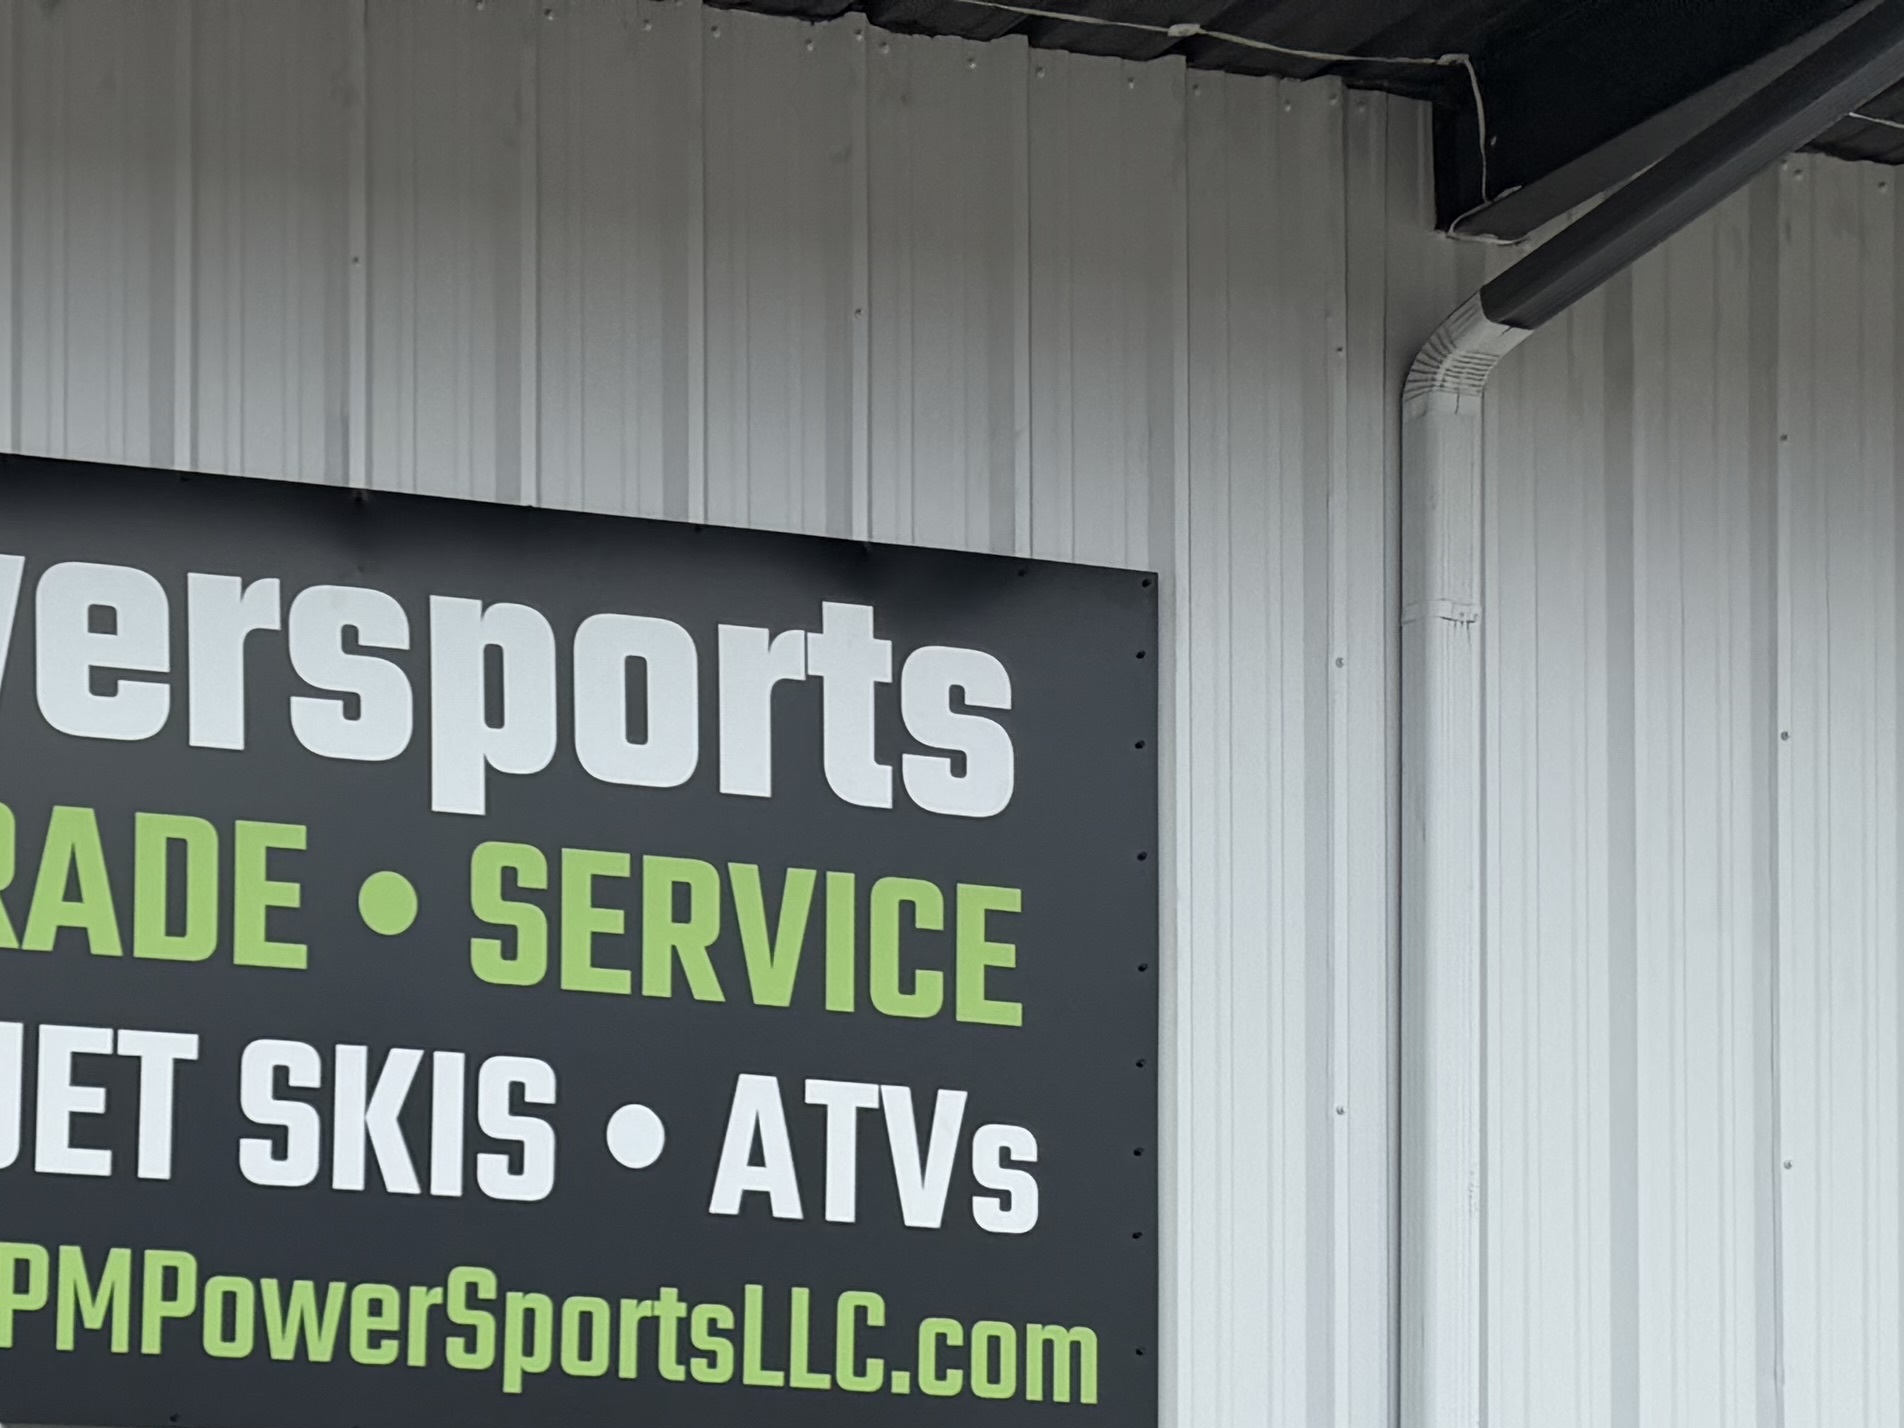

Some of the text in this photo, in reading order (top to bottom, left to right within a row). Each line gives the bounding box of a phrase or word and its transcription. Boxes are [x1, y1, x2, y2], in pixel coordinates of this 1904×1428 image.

[470, 841, 1023, 1027] SERVICE
[239, 1039, 557, 1202] SKIS
[709, 1074, 1039, 1234] ATVs
